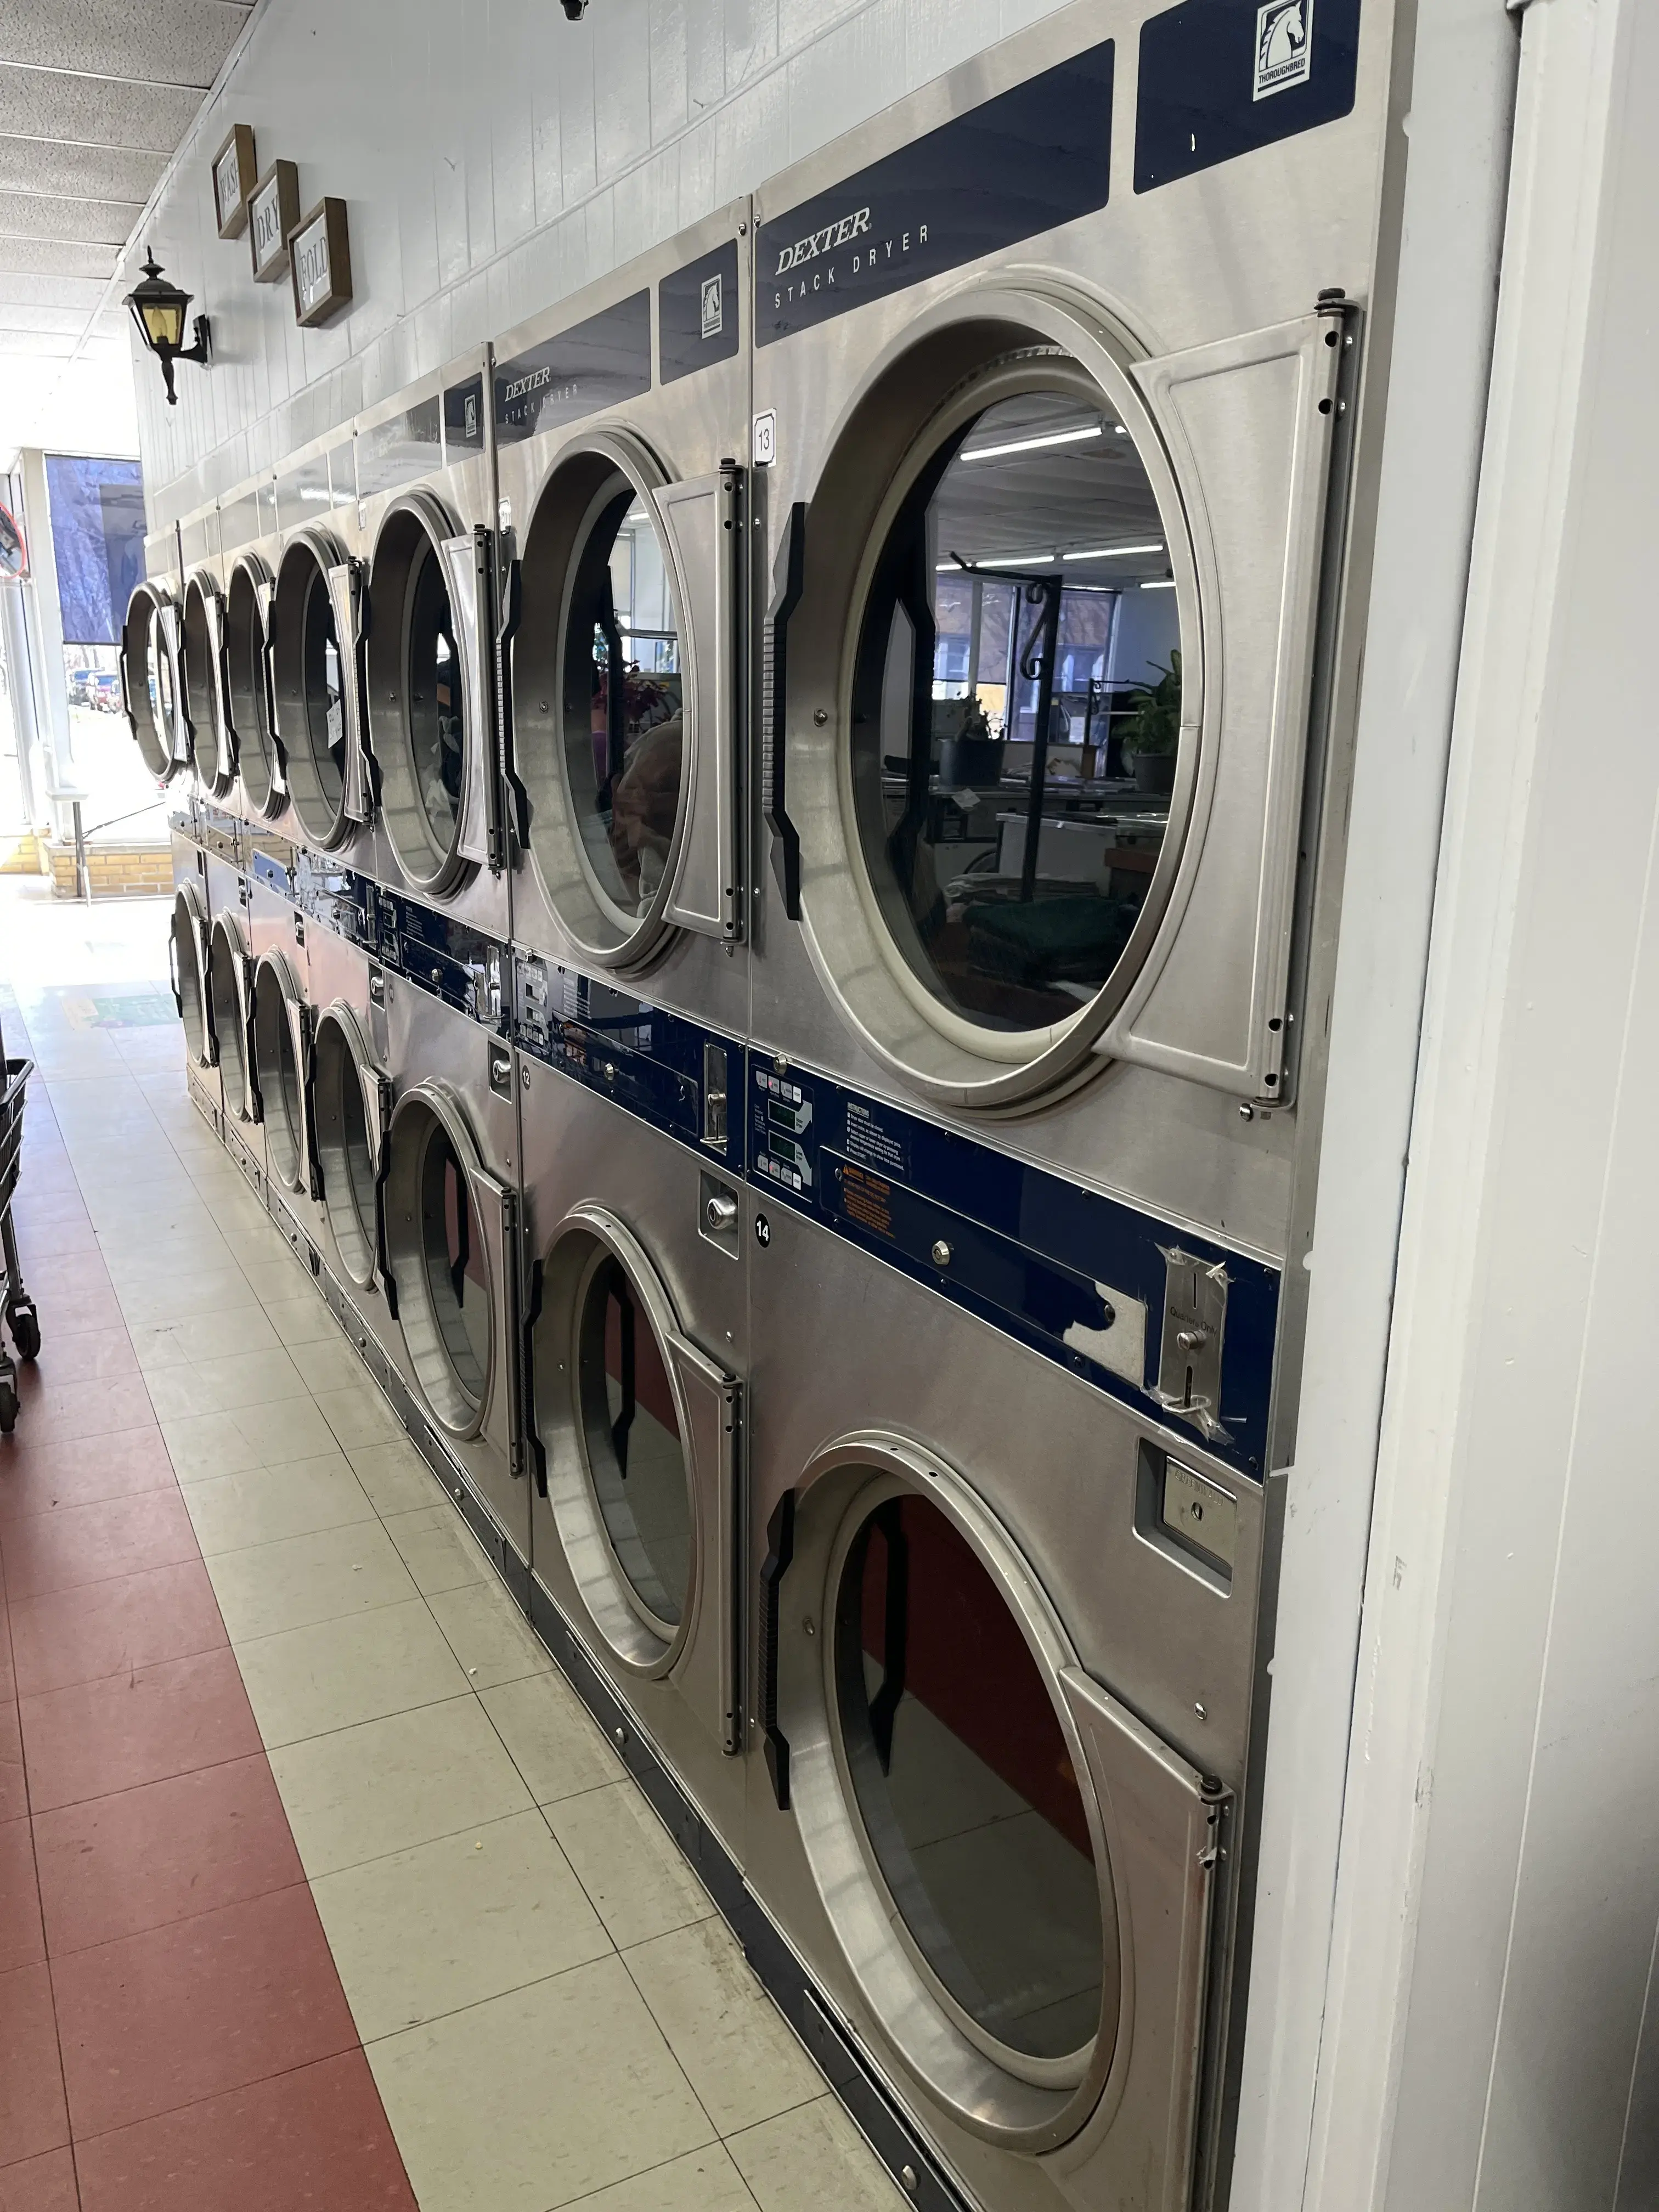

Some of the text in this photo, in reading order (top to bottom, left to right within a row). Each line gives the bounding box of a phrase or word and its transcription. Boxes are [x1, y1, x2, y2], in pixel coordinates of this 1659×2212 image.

[1259, 58, 1305, 84] THOROUGHBRED
[257, 193, 279, 250] DRY
[775, 207, 871, 275] DEXTER
[300, 236, 328, 292] FOLD
[775, 224, 928, 309] STACK DRYER
[505, 366, 550, 402] DEXTER
[505, 384, 577, 424] STACK DRYER
[759, 428, 770, 451] 13
[523, 1070, 530, 1085] 12
[757, 1220, 769, 1242] 14
[1201, 1321, 1217, 1338] Only
